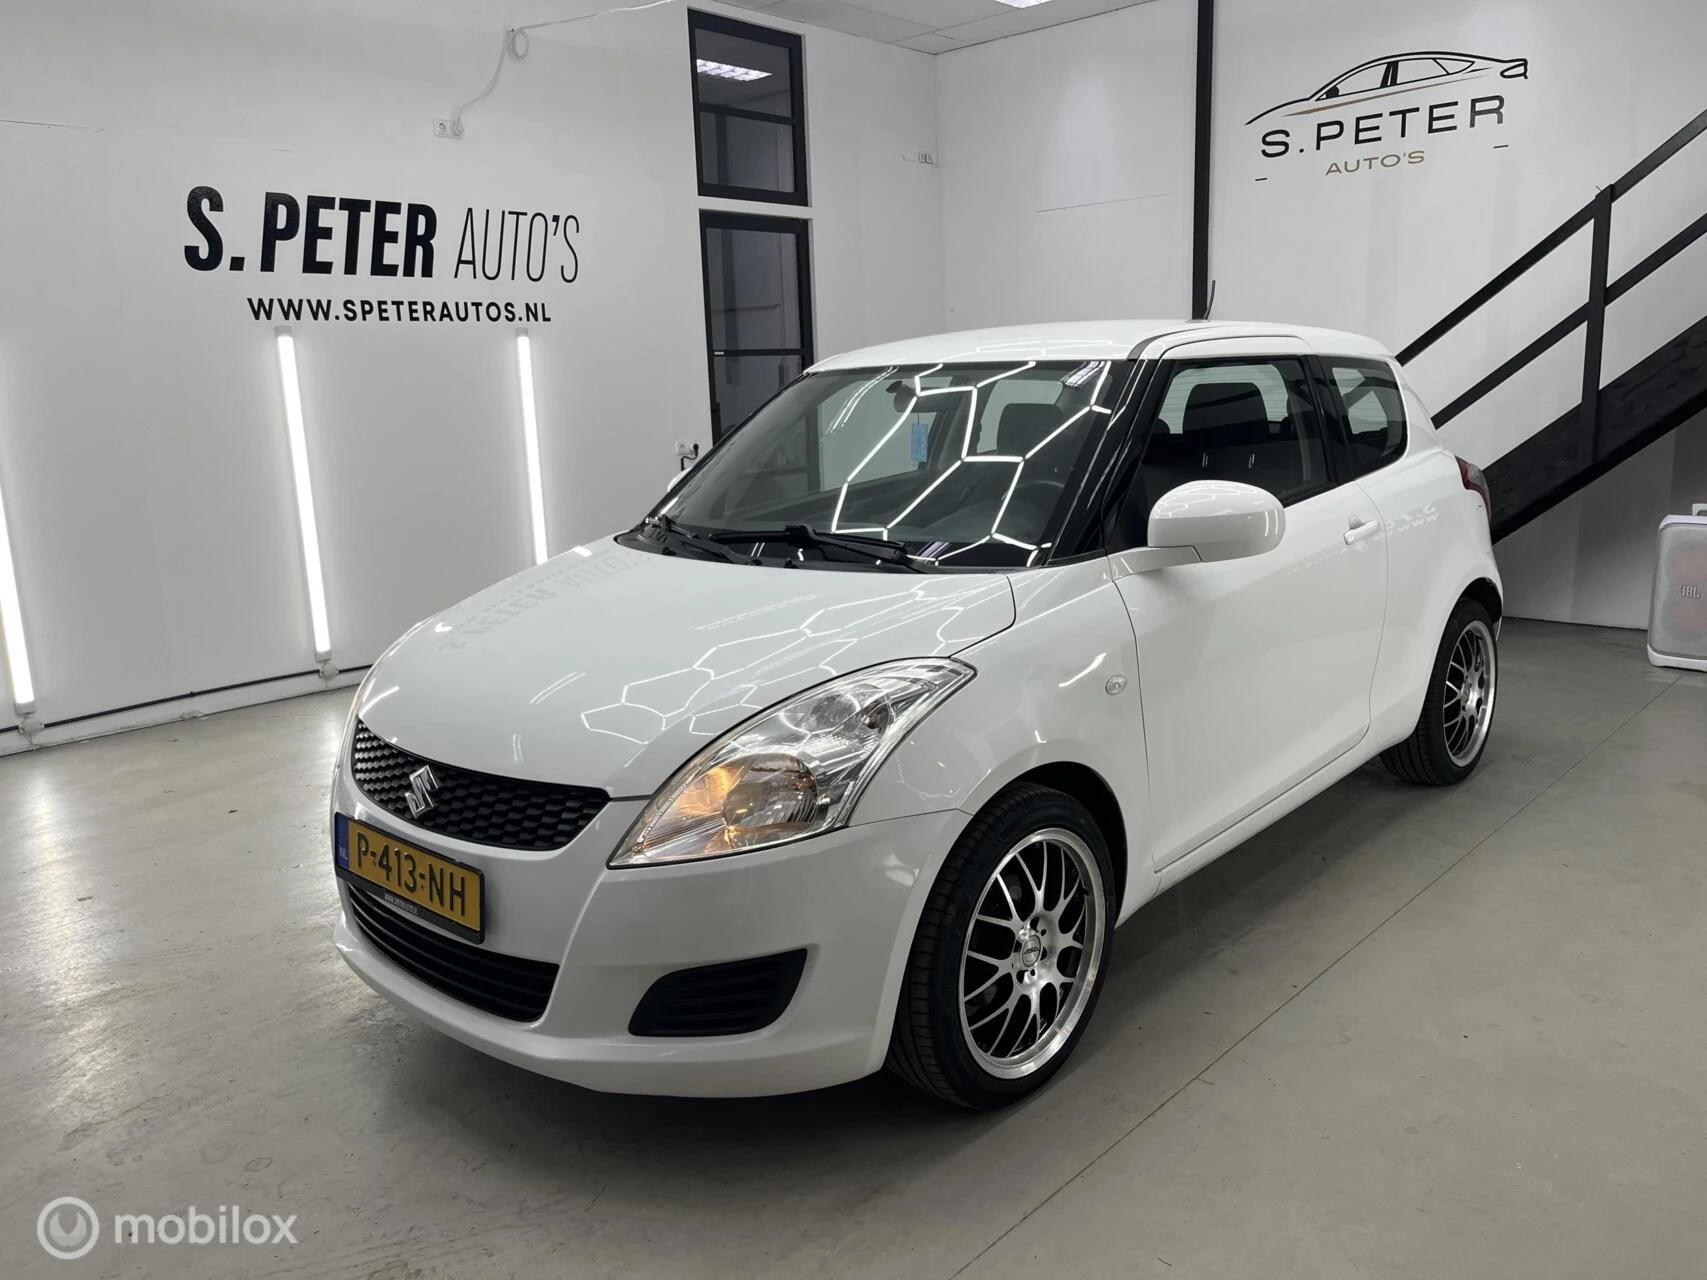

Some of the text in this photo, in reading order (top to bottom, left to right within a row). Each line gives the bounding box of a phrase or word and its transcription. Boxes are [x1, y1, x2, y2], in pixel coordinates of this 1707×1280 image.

[1325, 150, 1425, 176] AUTO'S
[454, 207, 580, 283] AUTO'S
[247, 297, 551, 322] WWW.SPETERAUTOS.NL
[357, 832, 465, 917] P-413-NH
